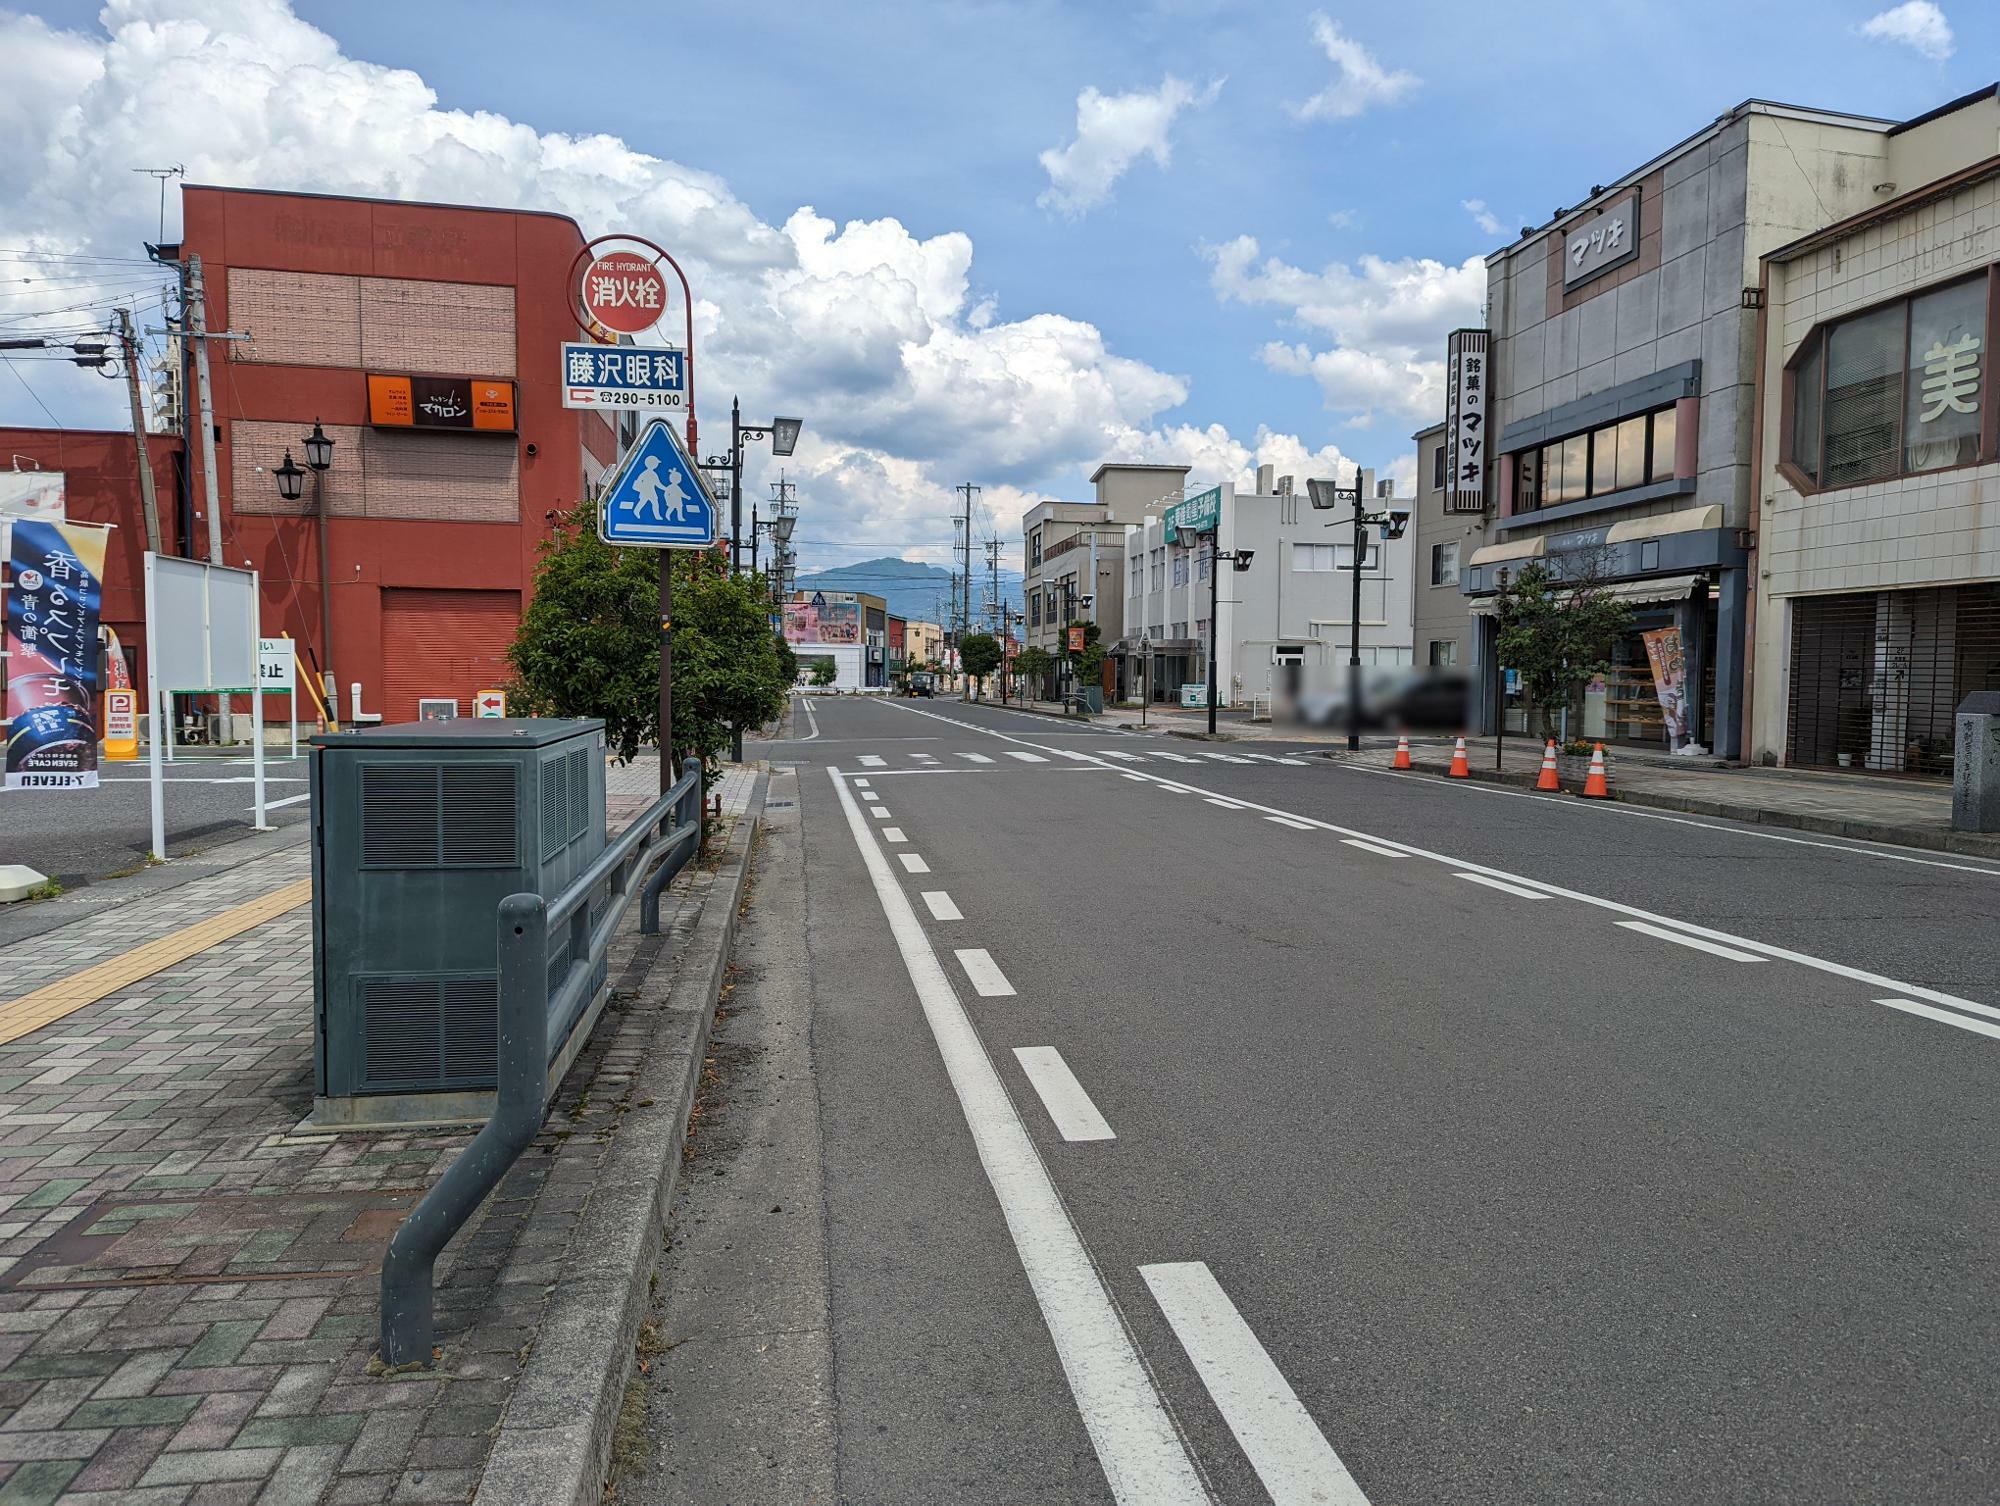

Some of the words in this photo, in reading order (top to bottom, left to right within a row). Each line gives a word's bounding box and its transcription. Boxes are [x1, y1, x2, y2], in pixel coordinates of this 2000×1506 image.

[1571, 218, 1624, 266] マツキ
[597, 261, 614, 271] FIRE
[616, 262, 651, 272] HYDRANT
[591, 276, 661, 308] 消火栓
[568, 352, 680, 387] 藤沢眼科
[1919, 333, 1981, 423] 美
[419, 403, 467, 418] マカロン
[614, 393, 681, 406] 290-5100
[1461, 357, 1482, 482] 銘菓のマツキ
